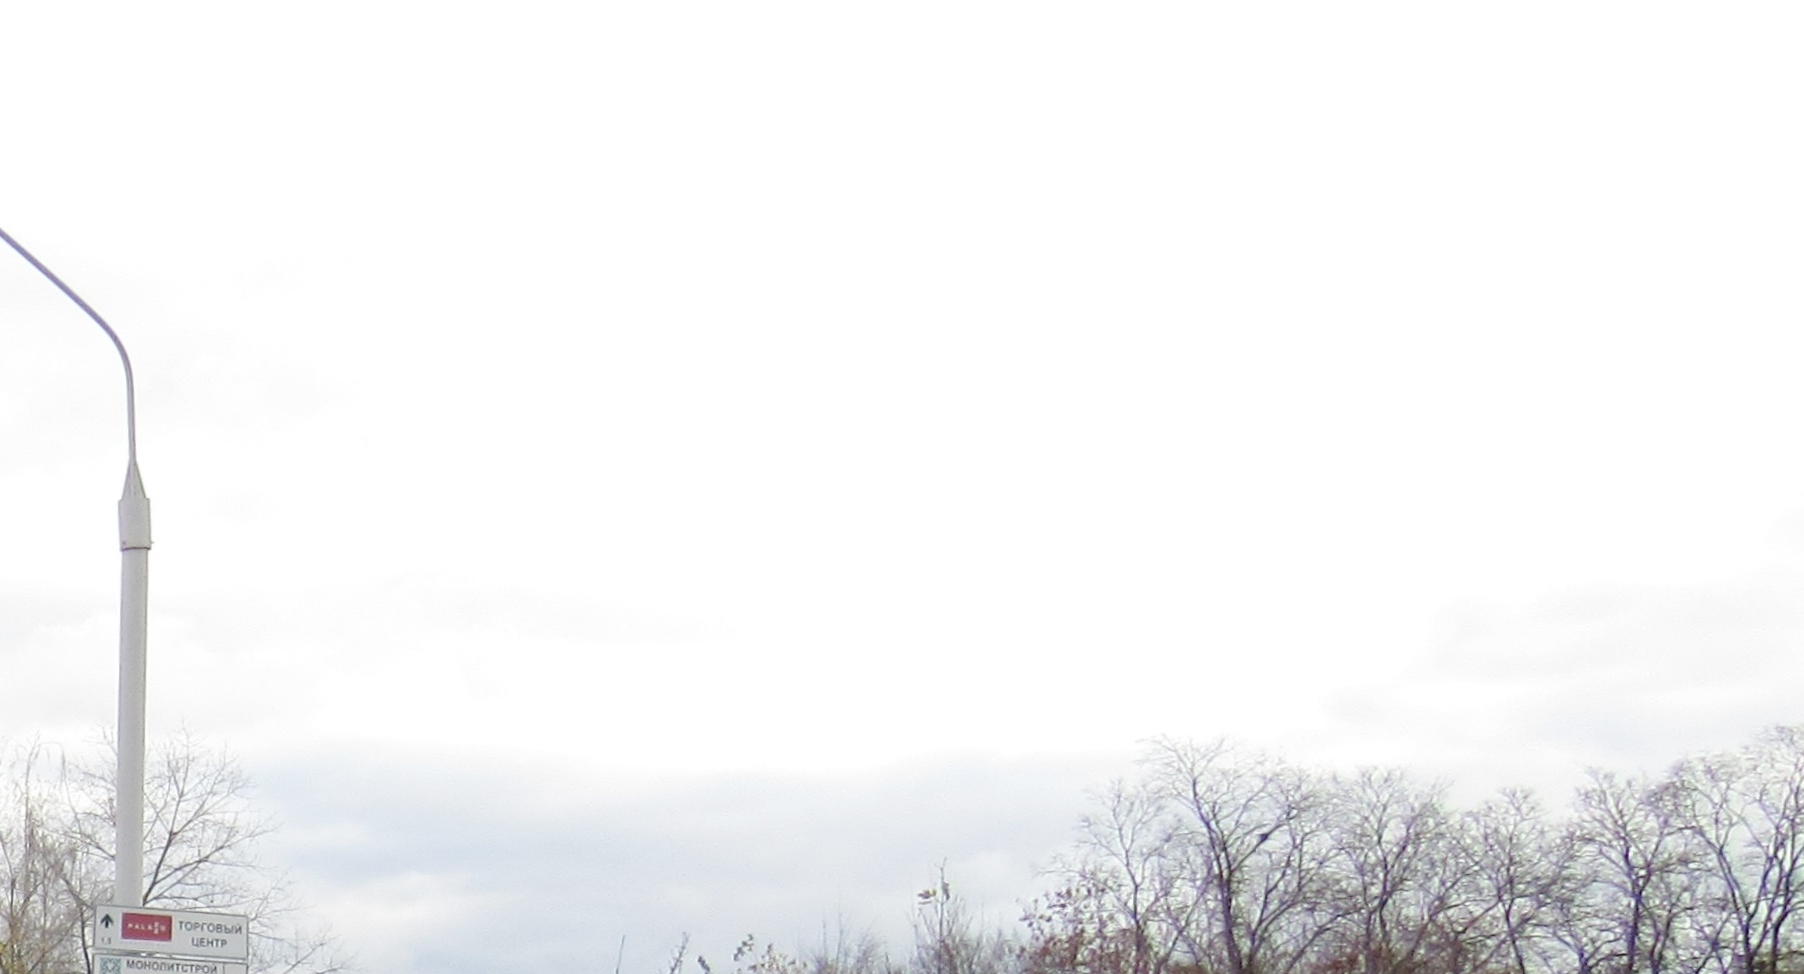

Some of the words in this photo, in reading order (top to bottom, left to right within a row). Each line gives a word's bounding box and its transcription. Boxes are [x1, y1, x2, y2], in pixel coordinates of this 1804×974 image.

[178, 920, 242, 935] ТОРГОВЫЙ
[192, 937, 227, 949] ЦЕНТР
[126, 960, 218, 974] МОНОЛИТСТРОЙ
